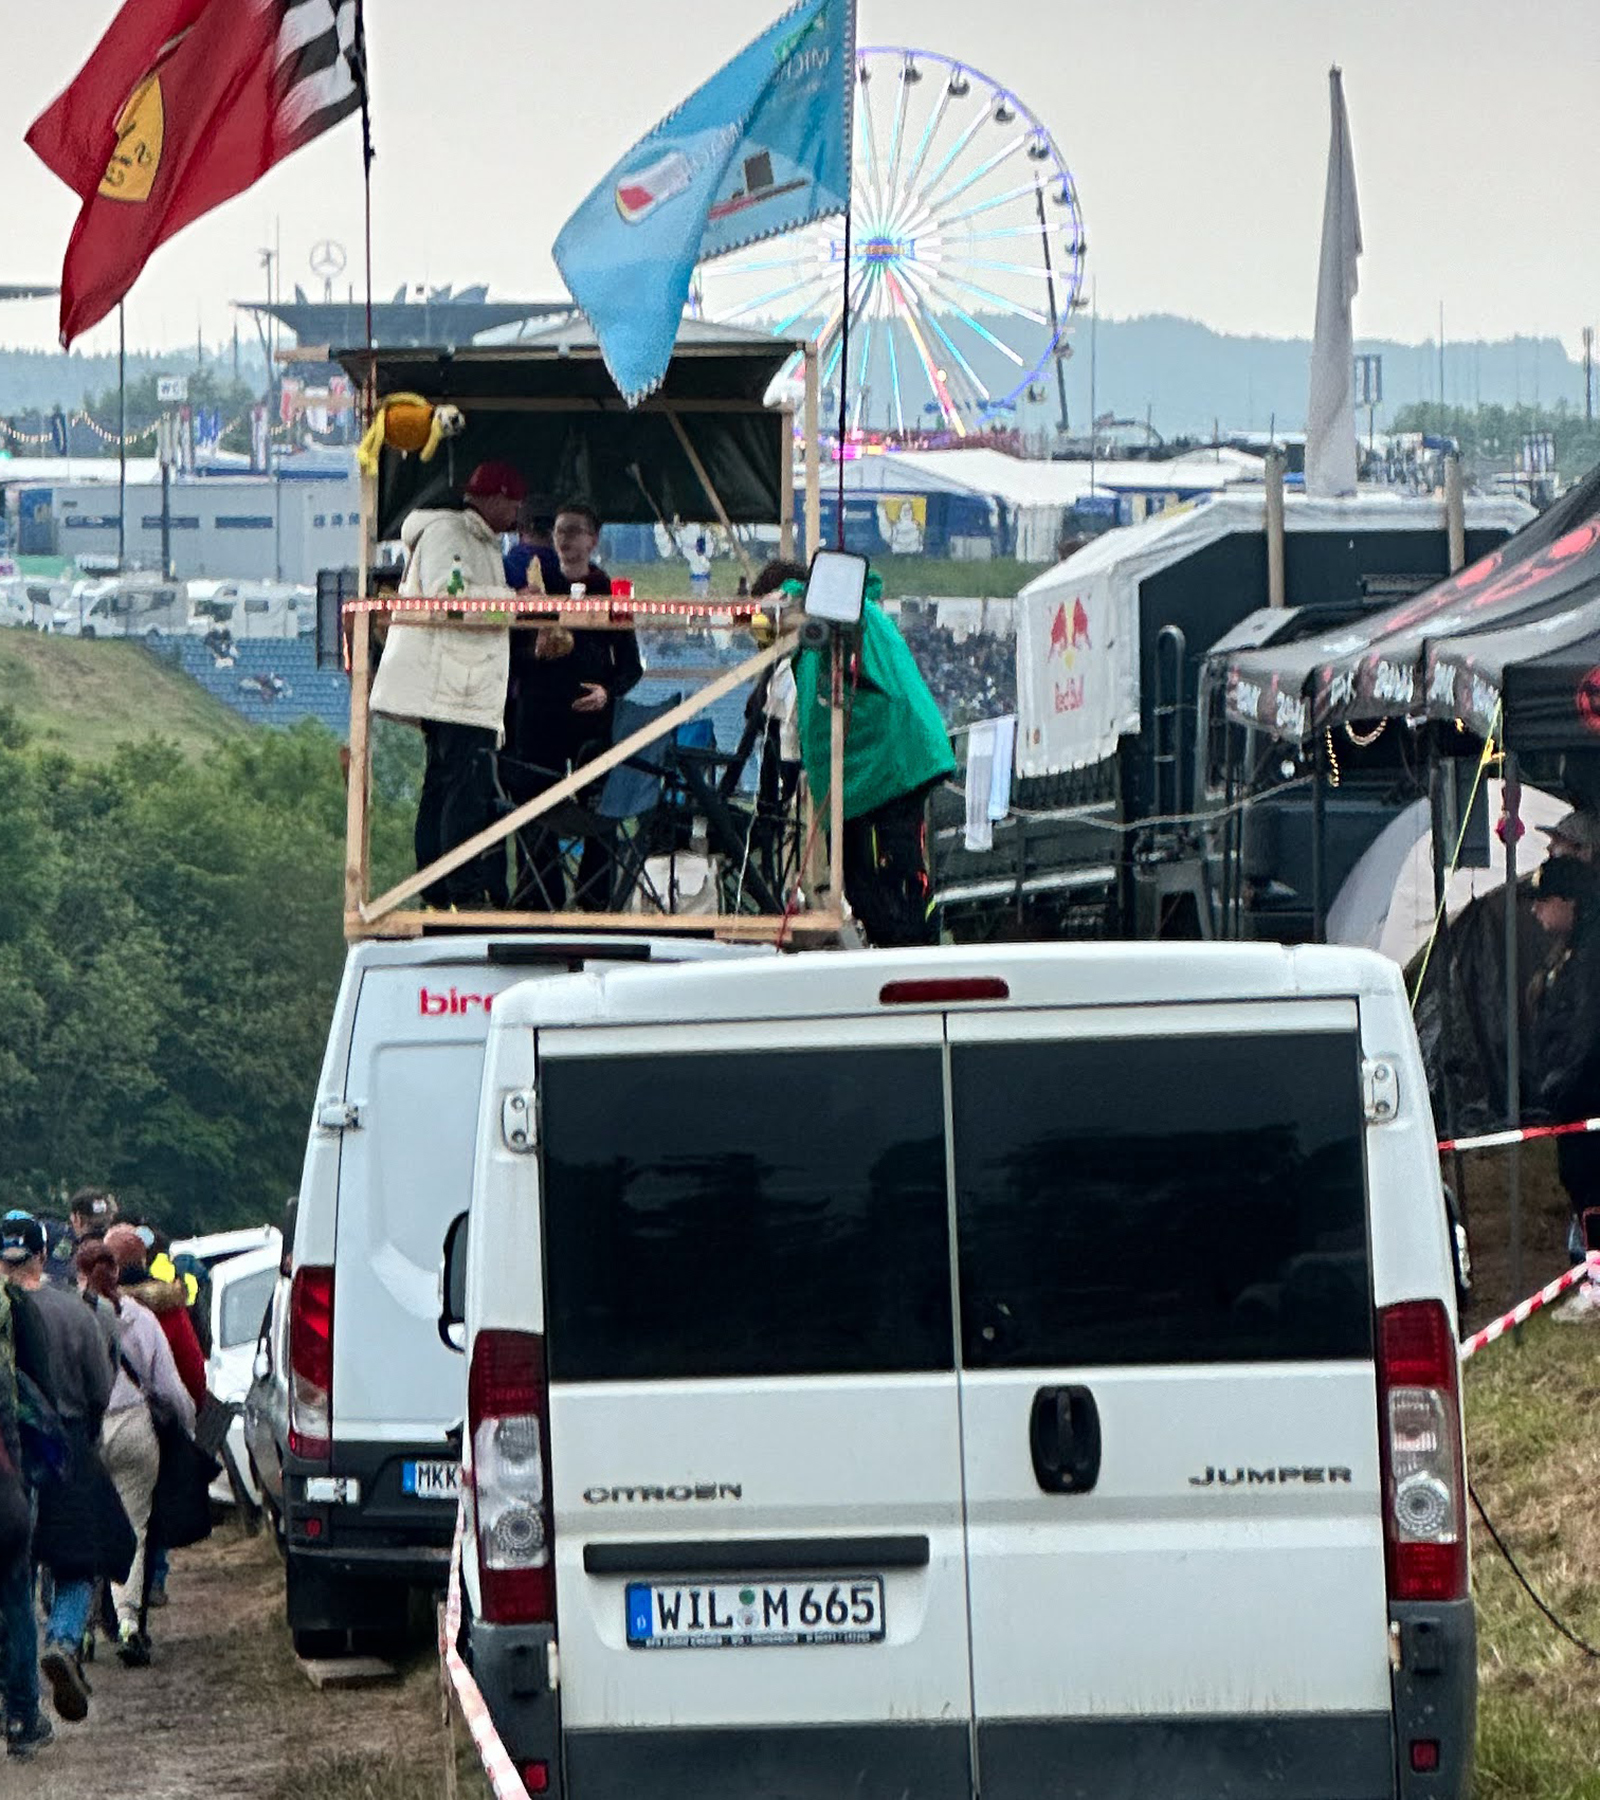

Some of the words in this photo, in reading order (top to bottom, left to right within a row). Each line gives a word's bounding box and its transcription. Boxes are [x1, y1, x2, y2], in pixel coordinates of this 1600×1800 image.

[418, 1464, 457, 1489] MKK
[1188, 1465, 1352, 1487] JUMPER
[656, 1591, 734, 1631] WIL
[799, 1586, 876, 1627] 665
